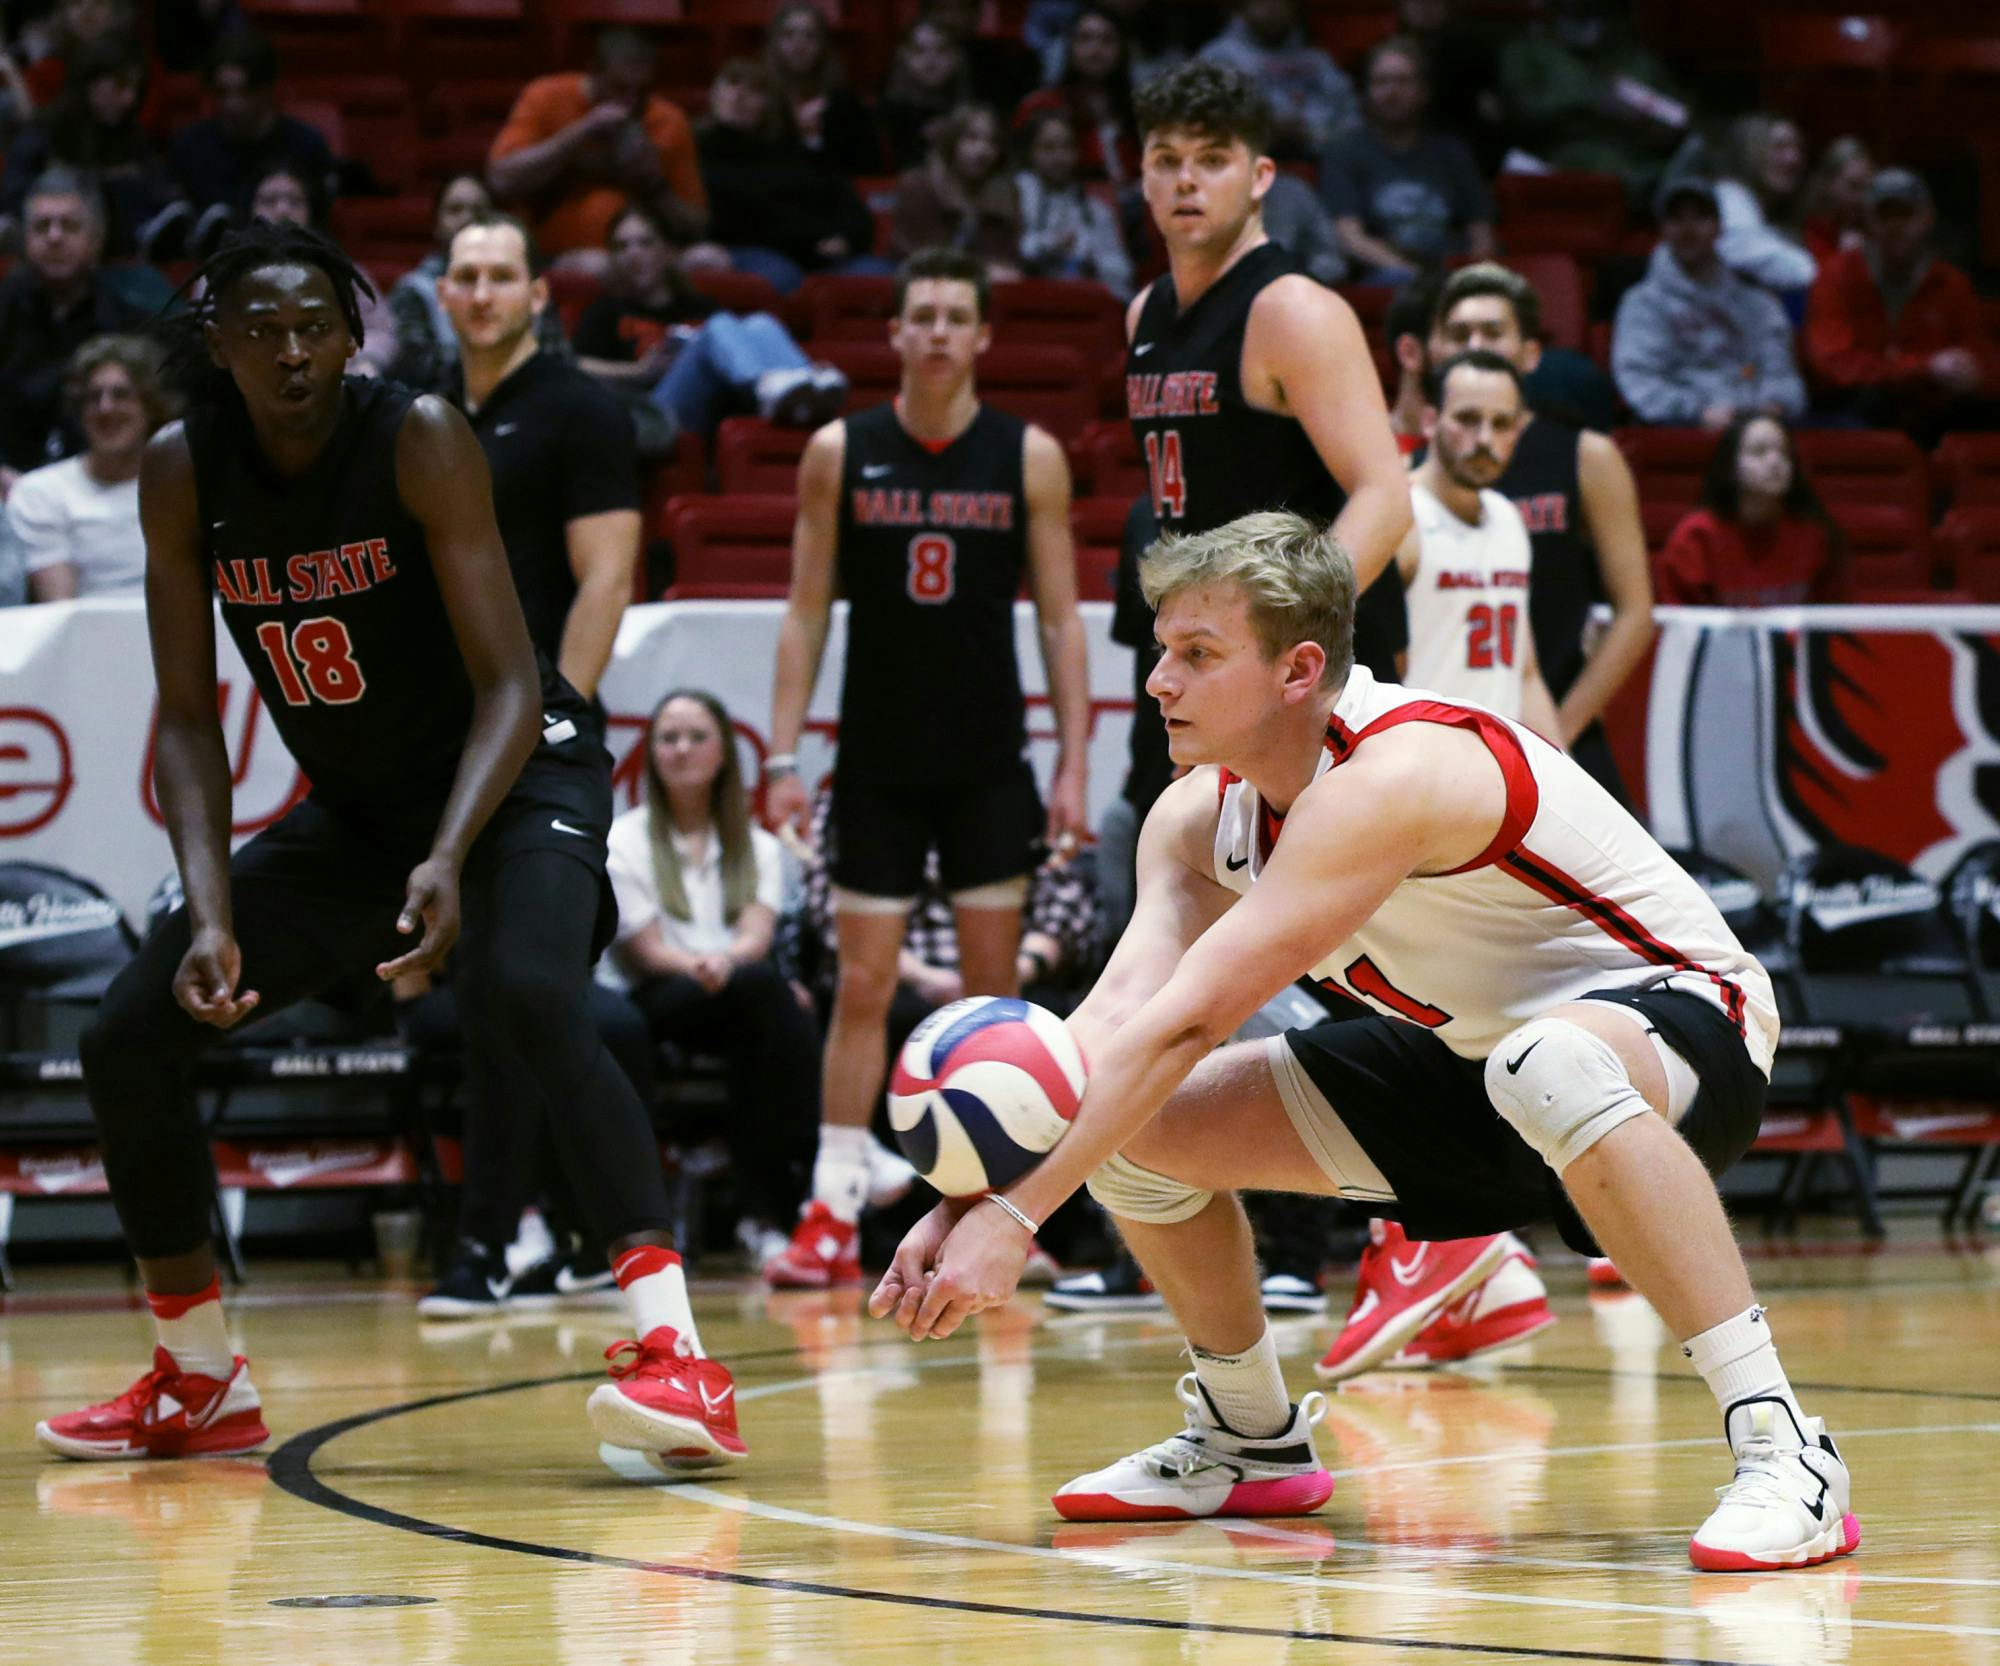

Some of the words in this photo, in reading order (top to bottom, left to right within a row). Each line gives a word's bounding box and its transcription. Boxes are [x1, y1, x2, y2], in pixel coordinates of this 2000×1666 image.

[853, 486, 925, 527] BALL
[929, 491, 1014, 531] STATE
[1143, 430, 1187, 520] 14
[216, 558, 283, 605] ALL
[286, 537, 398, 603] STATE
[906, 532, 957, 606] 8
[256, 615, 368, 706] 18
